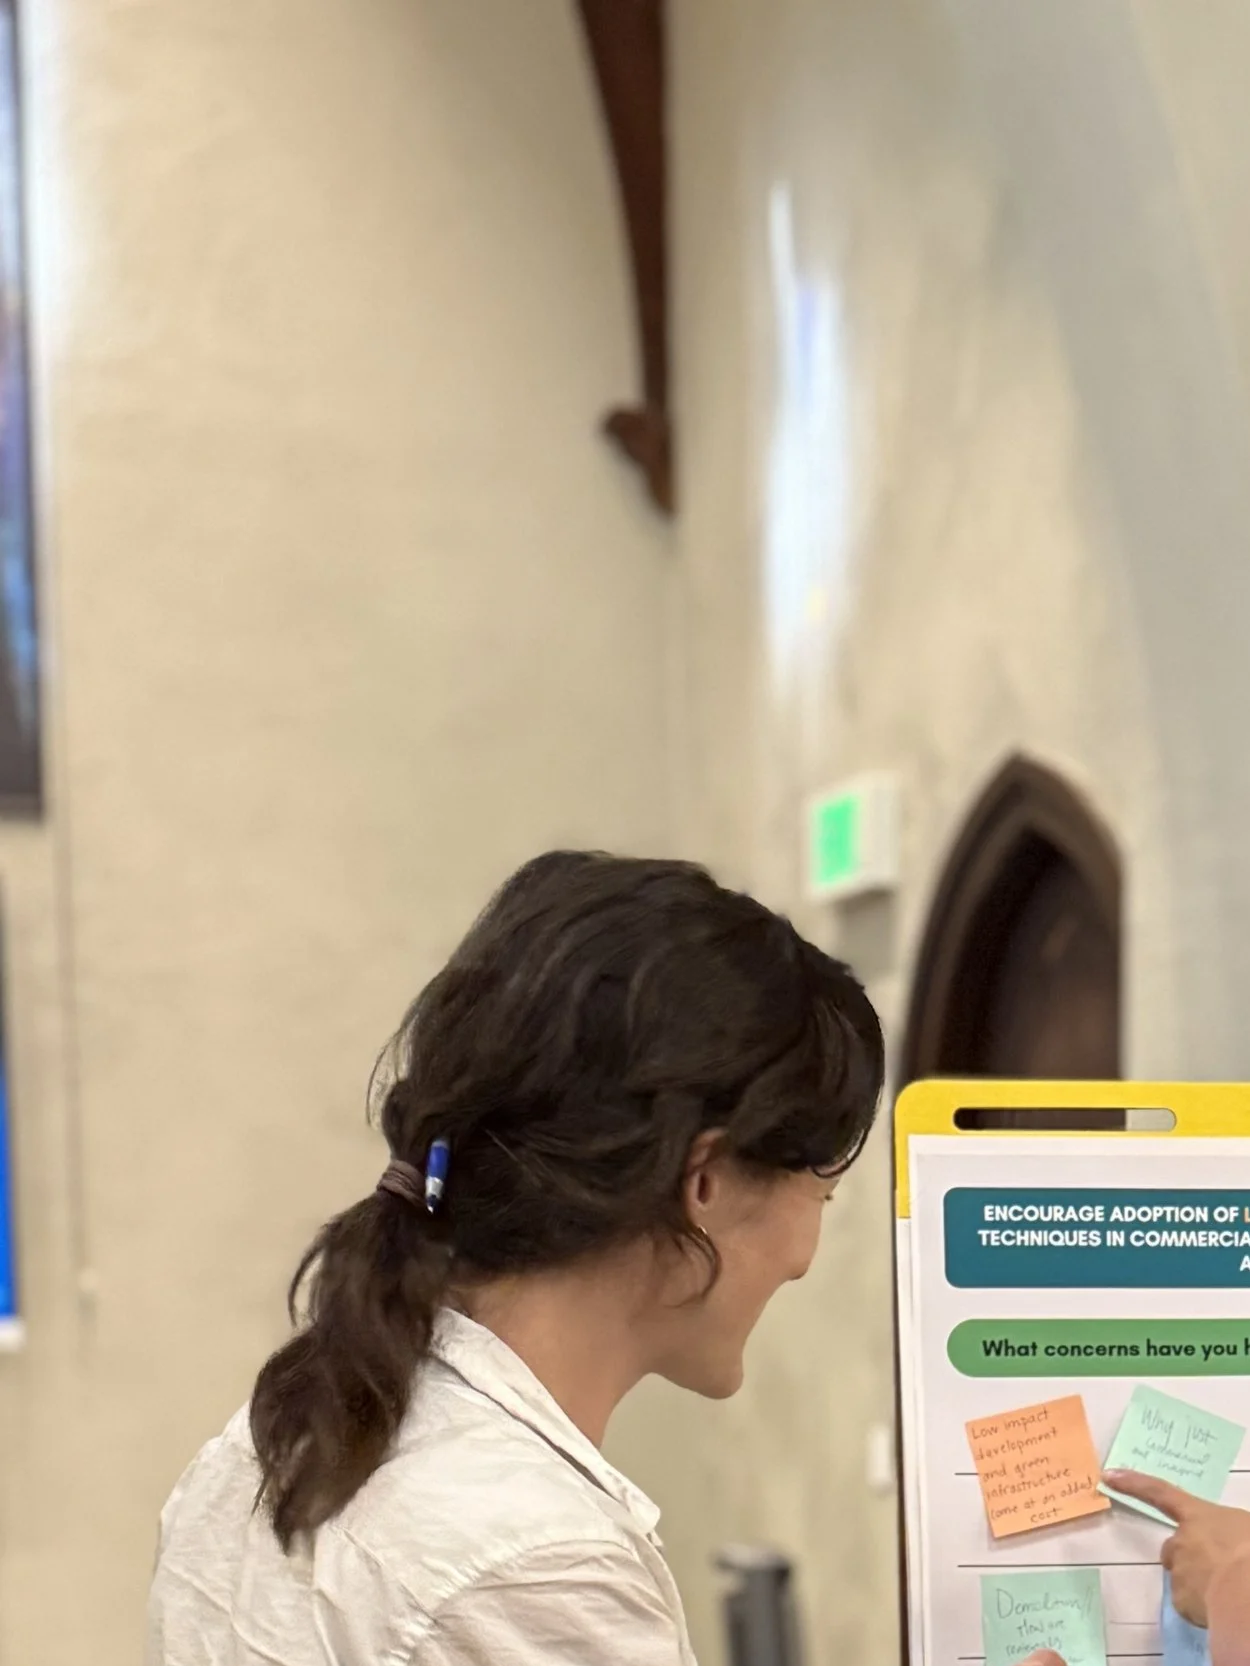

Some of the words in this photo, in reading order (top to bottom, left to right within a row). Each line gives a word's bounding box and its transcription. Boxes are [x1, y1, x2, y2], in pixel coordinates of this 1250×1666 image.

[983, 1205, 1105, 1222] ENCOURAGE
[1109, 1206, 1209, 1223] ADOPTION
[1213, 1206, 1240, 1223] OF
[977, 1229, 1102, 1247] TECHNIQUES
[1106, 1230, 1125, 1247] IN
[982, 1339, 1038, 1357] What
[1044, 1342, 1140, 1357] concerns
[1146, 1338, 1196, 1356] have
[1201, 1342, 1237, 1361] you
[1004, 1406, 1049, 1433] impact
[977, 1426, 1058, 1460] development
[983, 1463, 1007, 1482] and
[1014, 1456, 1050, 1478] green
[986, 1468, 1071, 1499] infrastructure
[1060, 1476, 1093, 1498] added
[1030, 1507, 1063, 1523] cost
